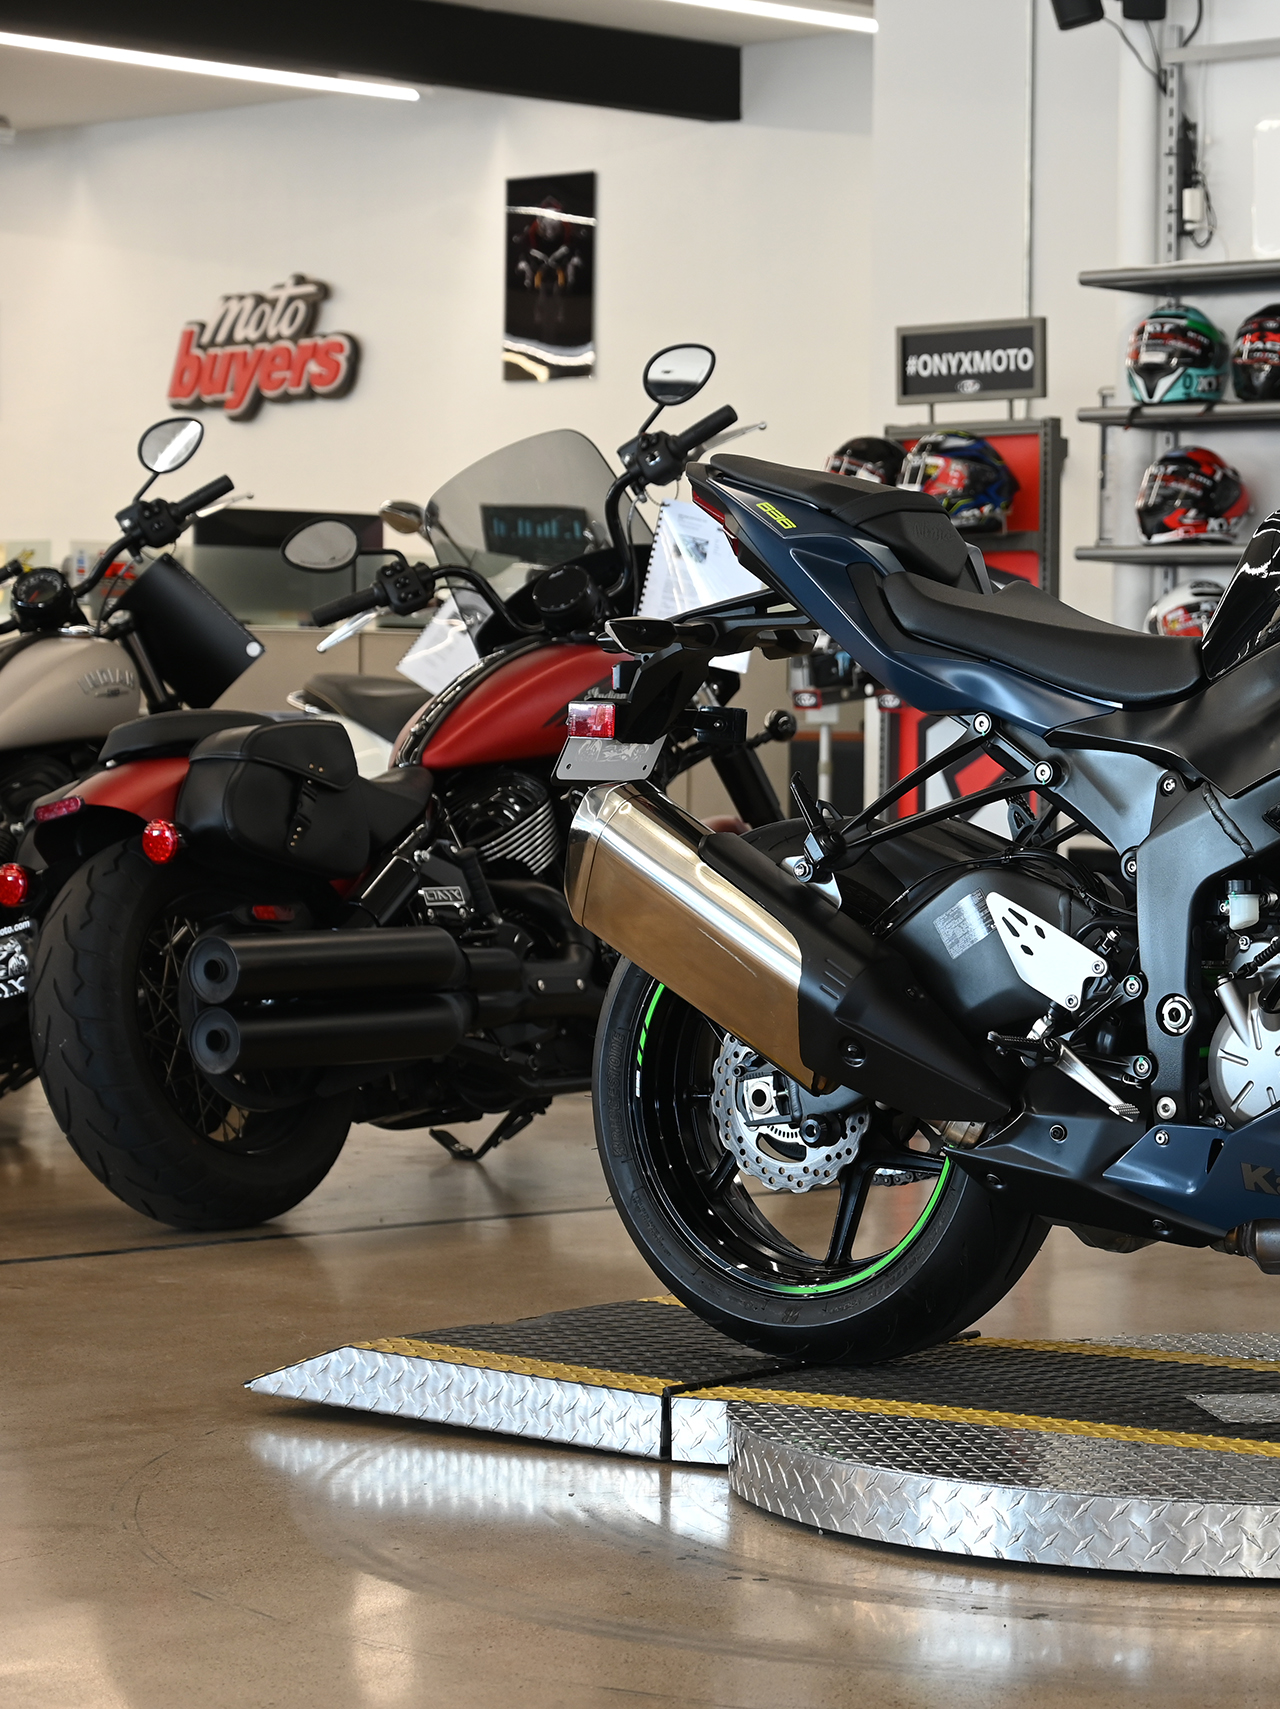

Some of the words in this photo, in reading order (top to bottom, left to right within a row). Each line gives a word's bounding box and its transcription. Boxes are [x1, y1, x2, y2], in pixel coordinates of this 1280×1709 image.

[166, 326, 349, 413] buyers
[906, 346, 1035, 378] #ONYXMOTO
[755, 501, 798, 530] 636
[77, 667, 136, 695] INDIAN
